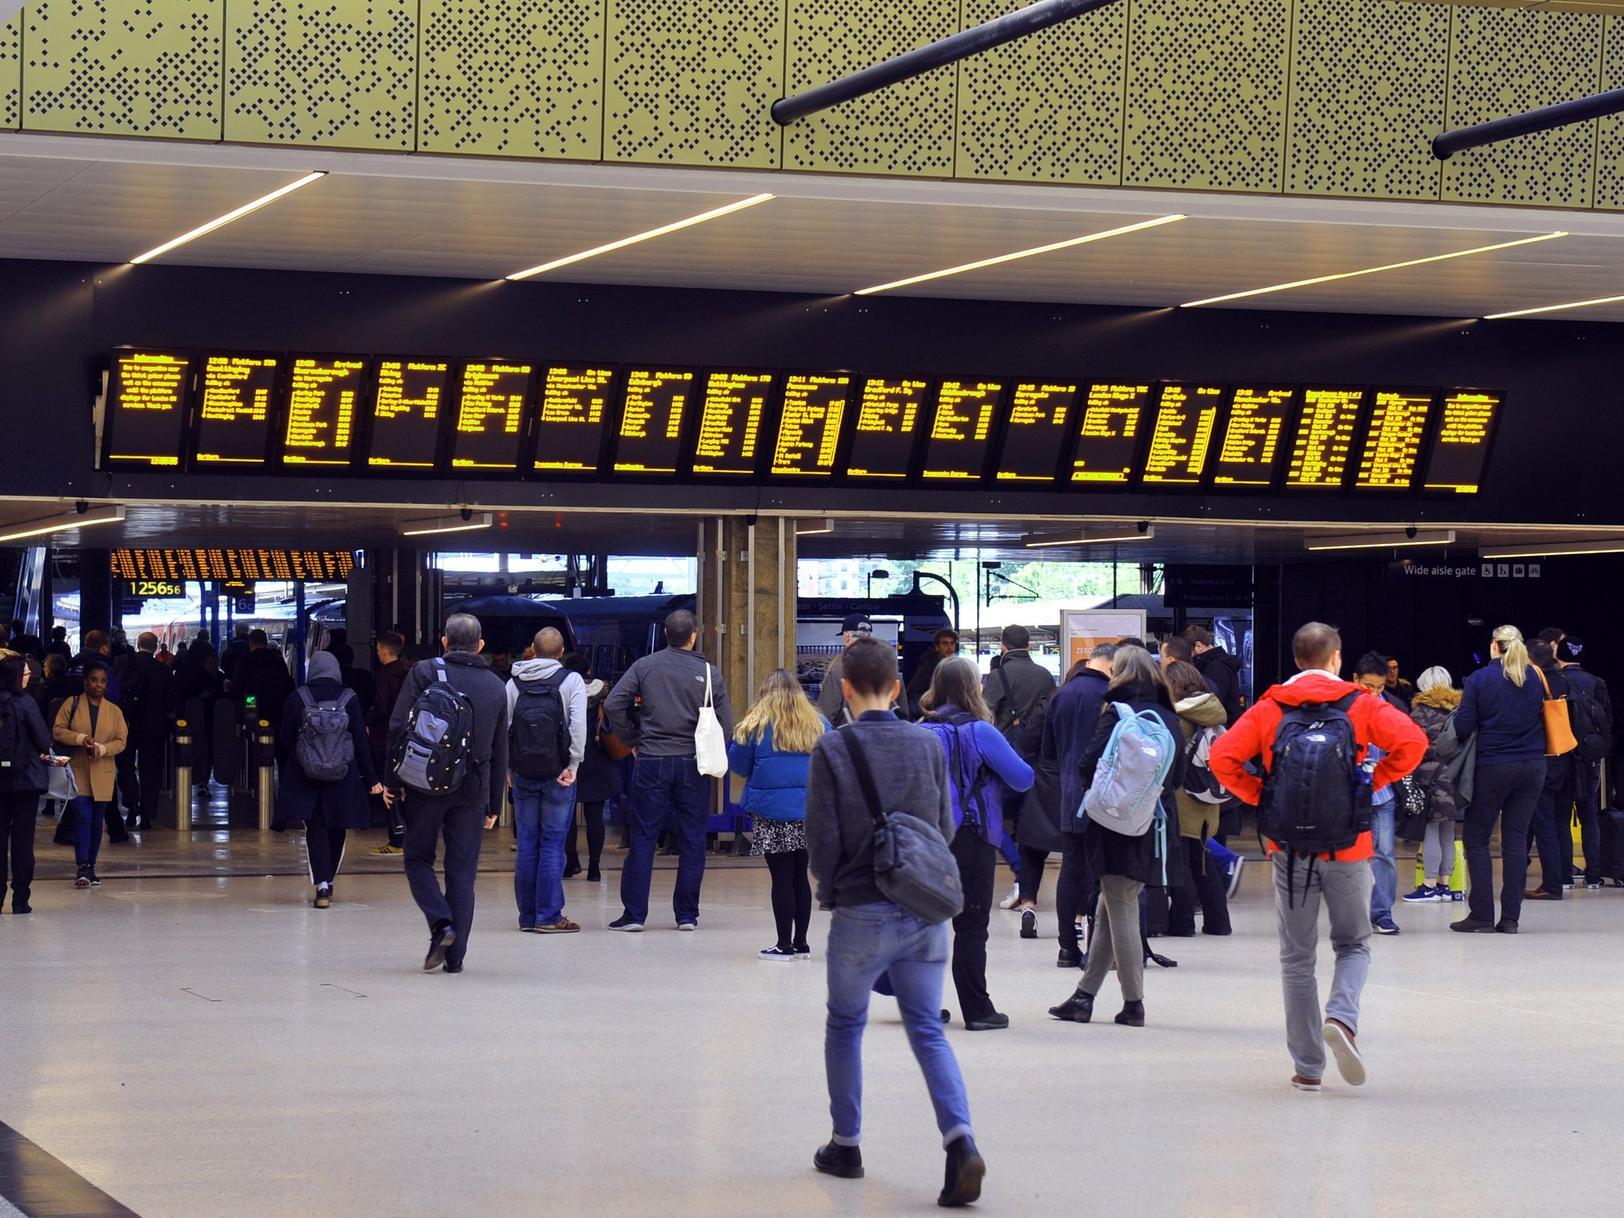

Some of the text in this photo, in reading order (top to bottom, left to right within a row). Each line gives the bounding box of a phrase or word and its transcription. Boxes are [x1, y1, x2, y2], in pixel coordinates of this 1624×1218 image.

[1402, 564, 1476, 578] Wide aisle gate
[238, 598, 254, 610] 6c
